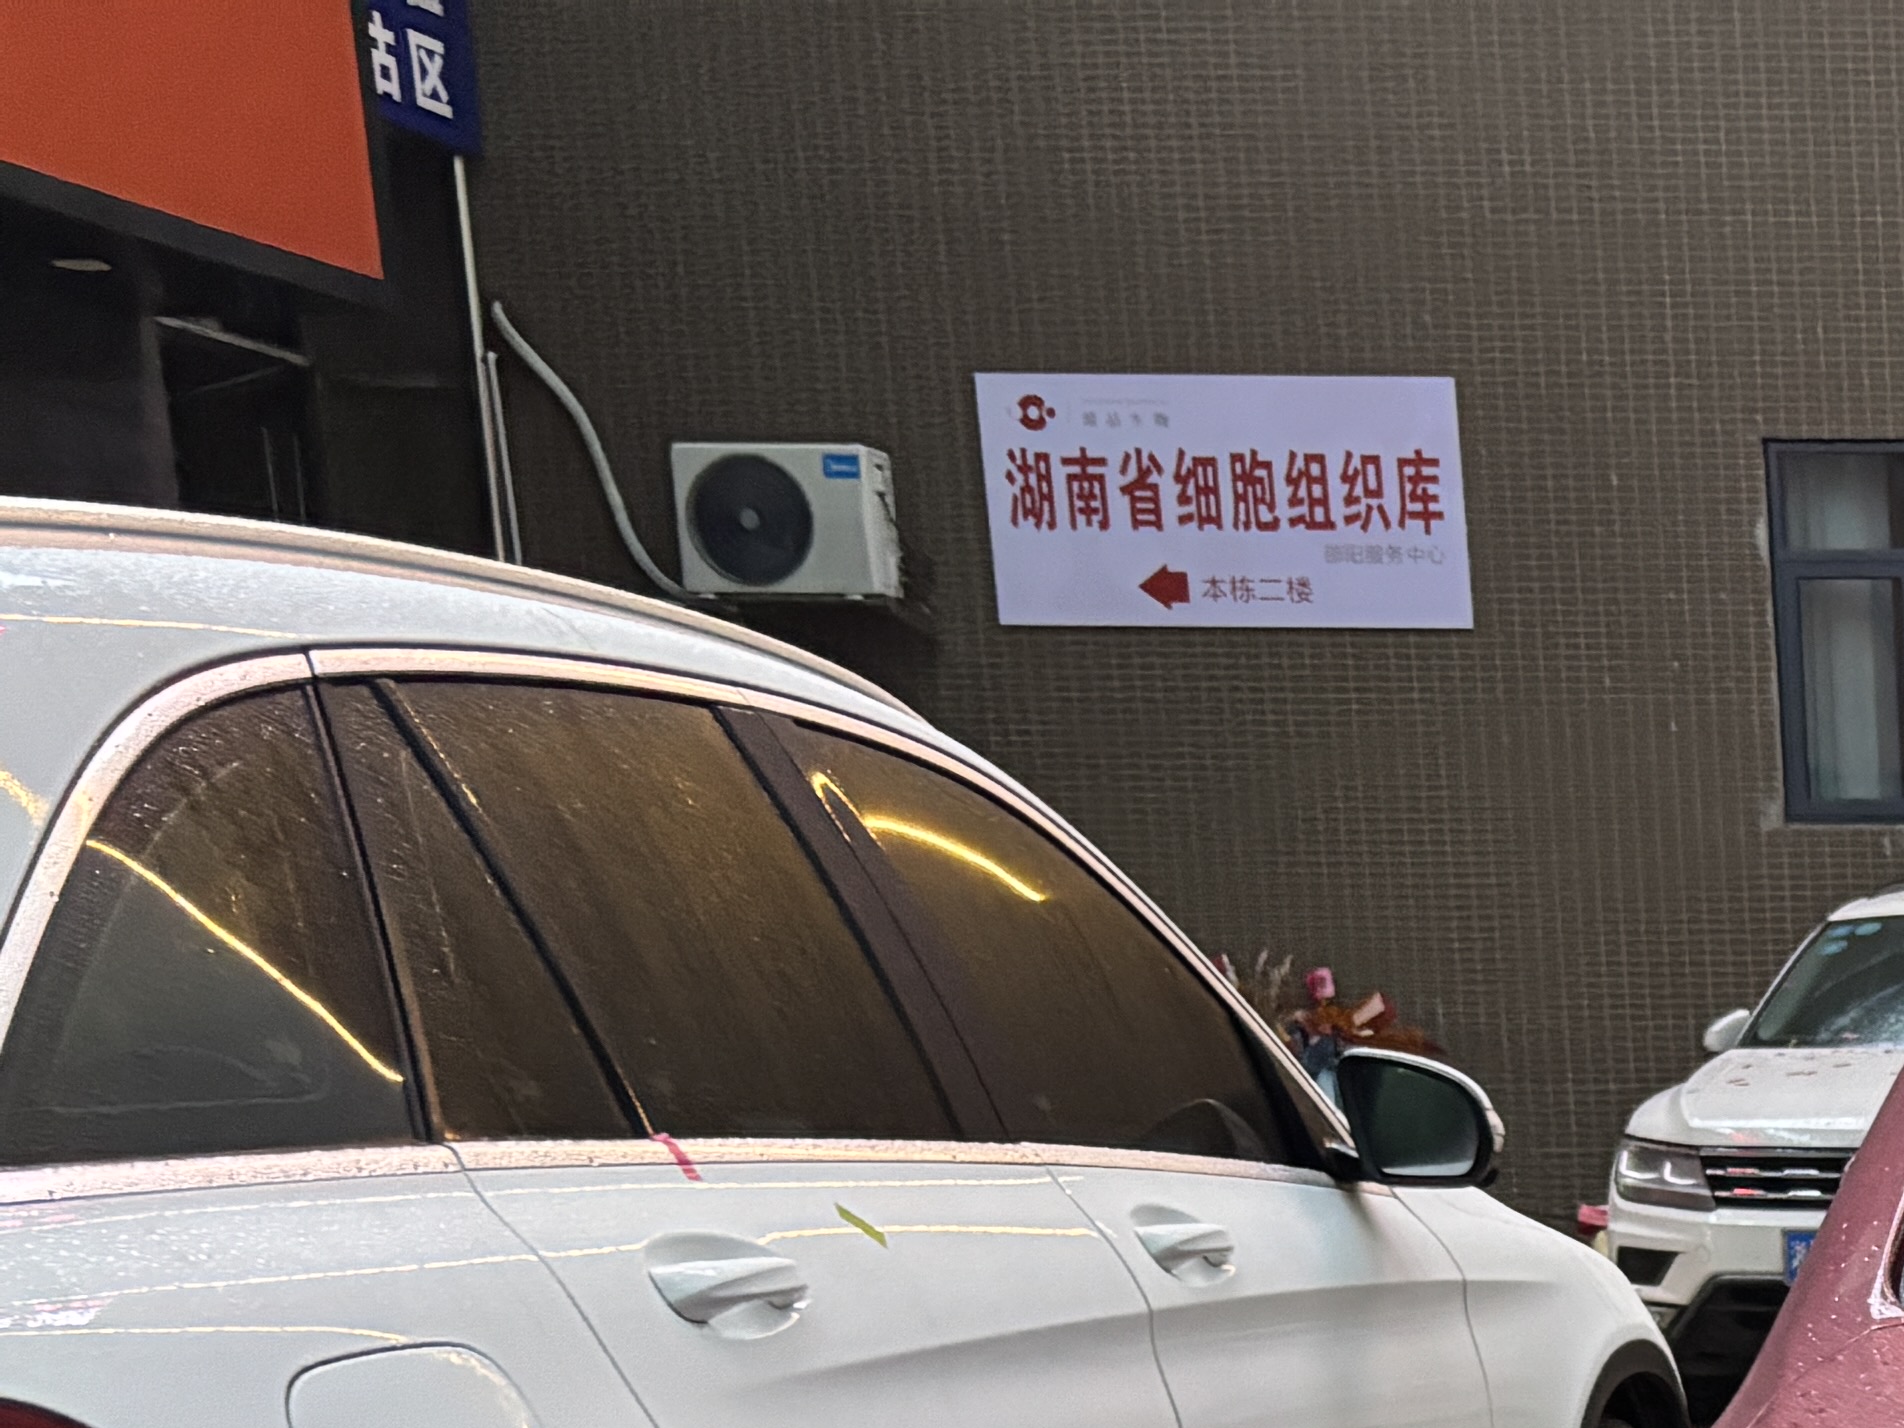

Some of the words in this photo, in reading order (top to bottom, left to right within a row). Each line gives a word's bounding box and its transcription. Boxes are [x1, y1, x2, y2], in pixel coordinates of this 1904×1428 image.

[1005, 447, 1445, 535] 湖南省细胞组织库
[1202, 576, 1314, 603] 本栋二楼
